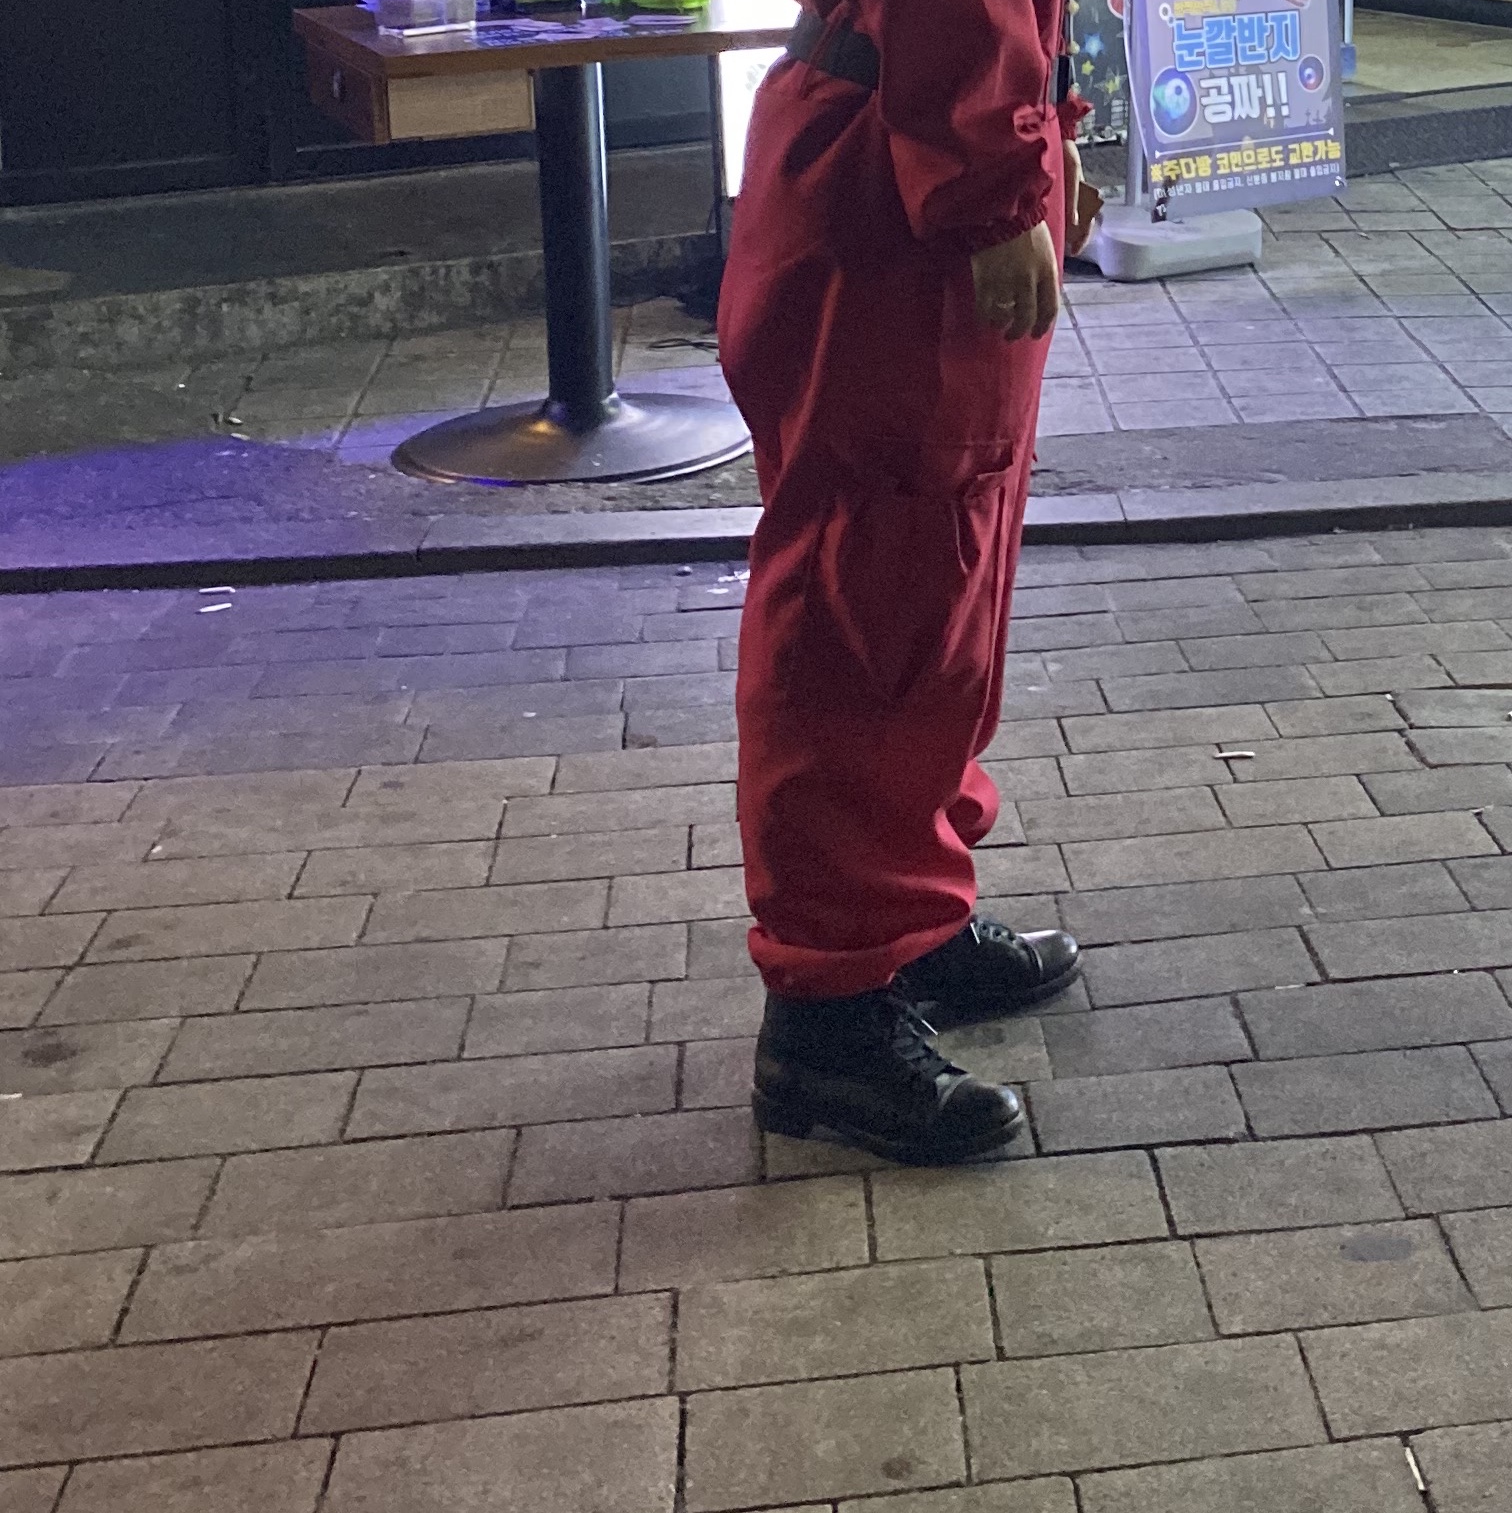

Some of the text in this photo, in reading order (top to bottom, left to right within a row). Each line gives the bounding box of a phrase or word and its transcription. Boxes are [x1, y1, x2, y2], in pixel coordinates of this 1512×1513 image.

[1173, 10, 1301, 72] 눈깔반지
[1199, 72, 1290, 124] 공짜!!
[1216, 145, 1285, 175] 코인으로도
